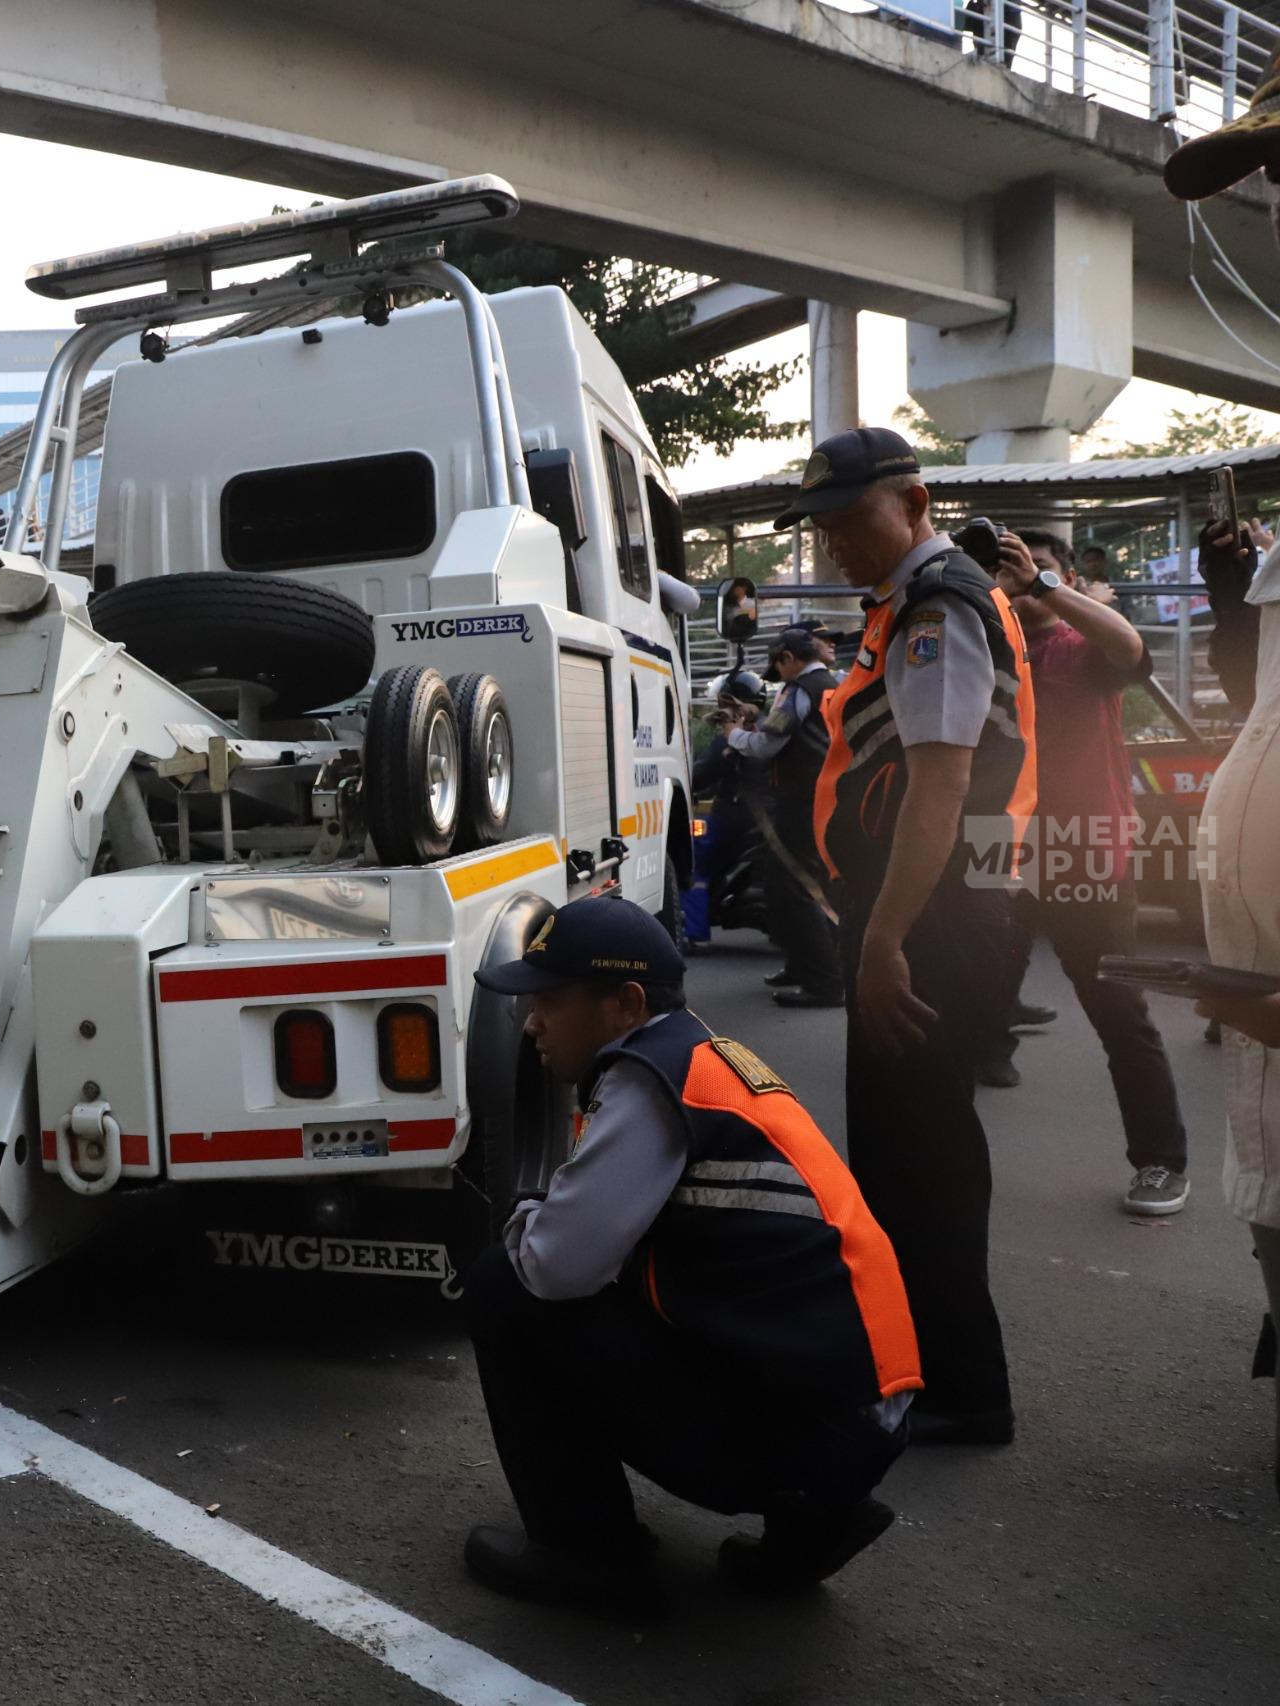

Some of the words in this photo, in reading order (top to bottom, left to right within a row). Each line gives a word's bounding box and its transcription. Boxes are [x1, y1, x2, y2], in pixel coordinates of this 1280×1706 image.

[391, 618, 455, 642] YMG
[458, 616, 522, 634] DEREK
[206, 1230, 320, 1270] YMG
[327, 1243, 441, 1273] DEREK
